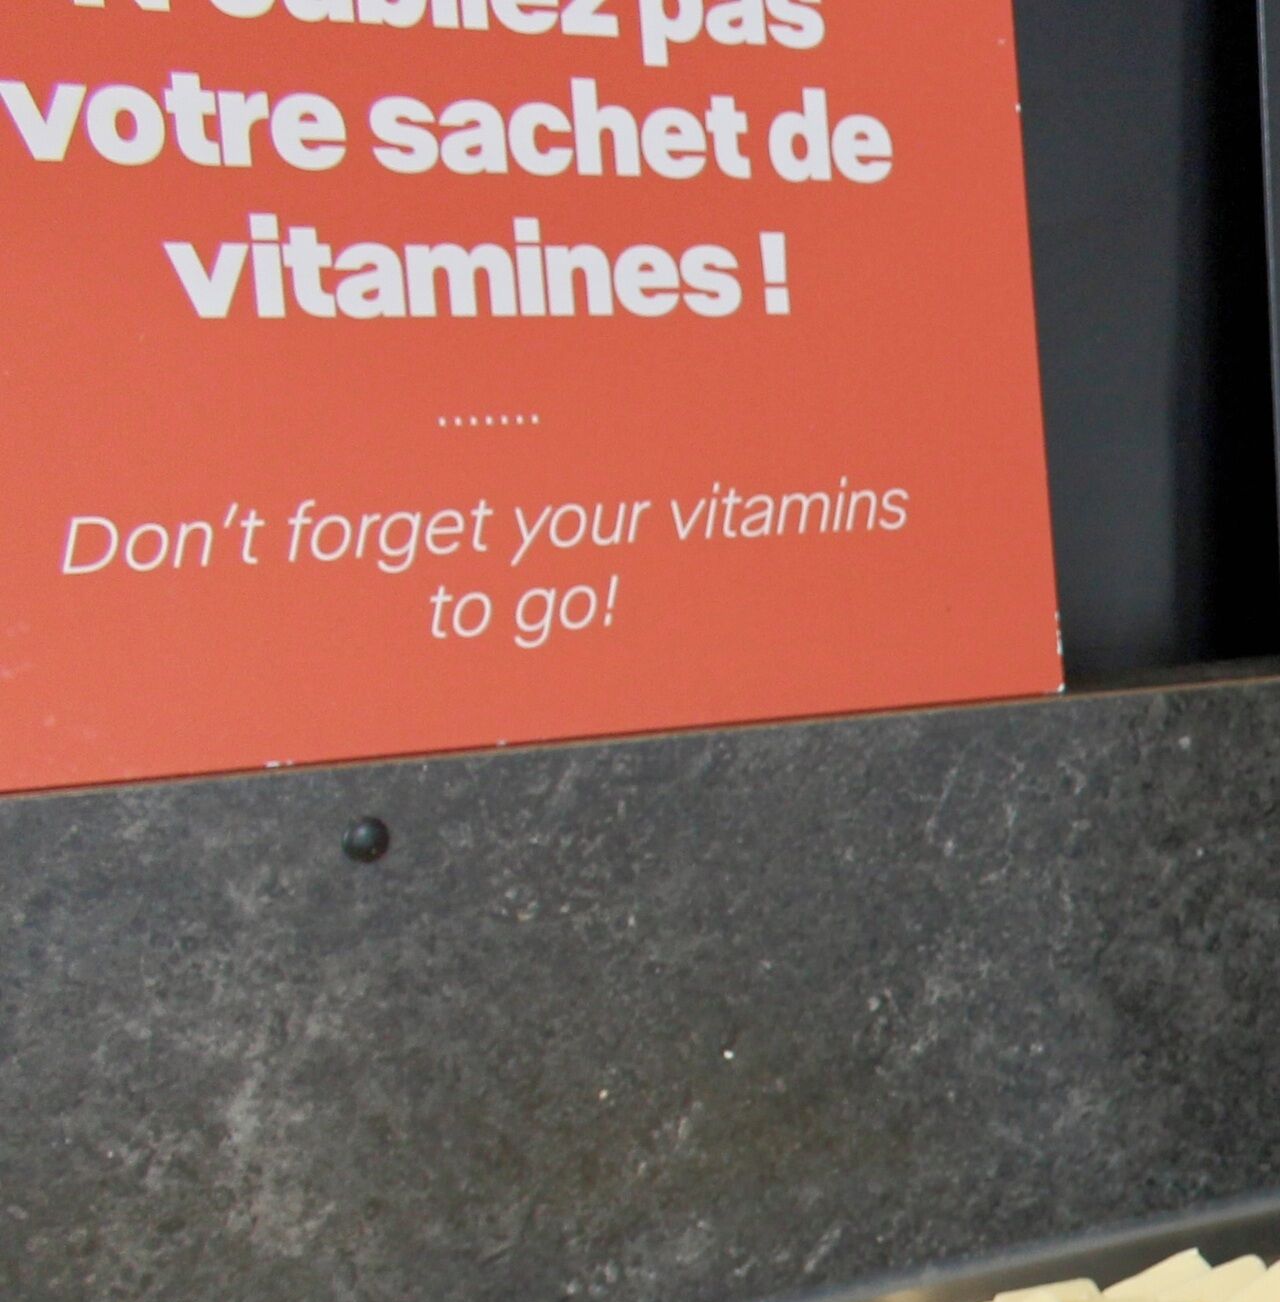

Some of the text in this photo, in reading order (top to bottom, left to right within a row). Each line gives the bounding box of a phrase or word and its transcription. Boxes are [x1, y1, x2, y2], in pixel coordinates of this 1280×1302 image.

[640, 0, 825, 67] pas
[0, 73, 893, 184] votre sachet de
[164, 213, 742, 319] vitamines
[287, 500, 493, 574] forget
[511, 499, 651, 566] your
[671, 475, 909, 540] vitamins
[430, 574, 619, 649] to go!
